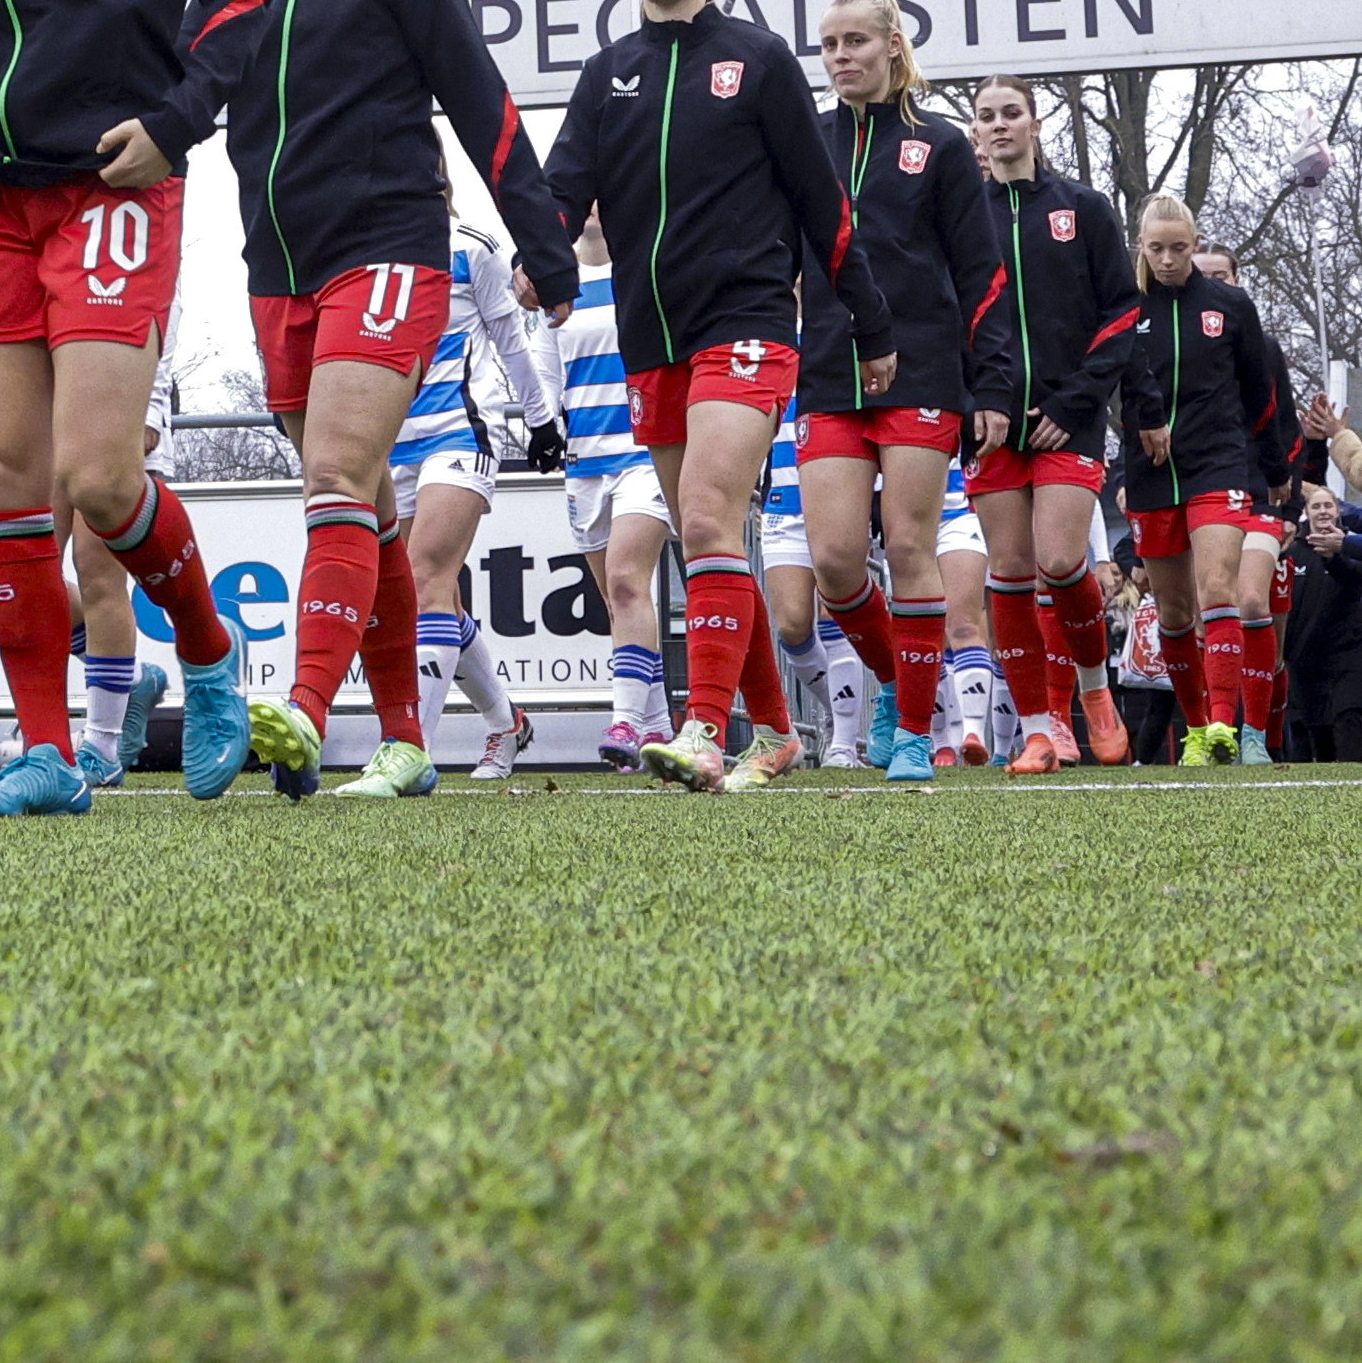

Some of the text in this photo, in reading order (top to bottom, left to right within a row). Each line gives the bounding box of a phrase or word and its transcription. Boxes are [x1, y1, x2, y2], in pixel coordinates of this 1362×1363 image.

[81, 200, 149, 271] 10
[366, 263, 415, 321] 11
[732, 339, 766, 361] 4
[302, 600, 359, 622] 1965
[688, 614, 739, 630] 1965
[1207, 643, 1242, 655] 1965
[1240, 667, 1273, 682] 1965
